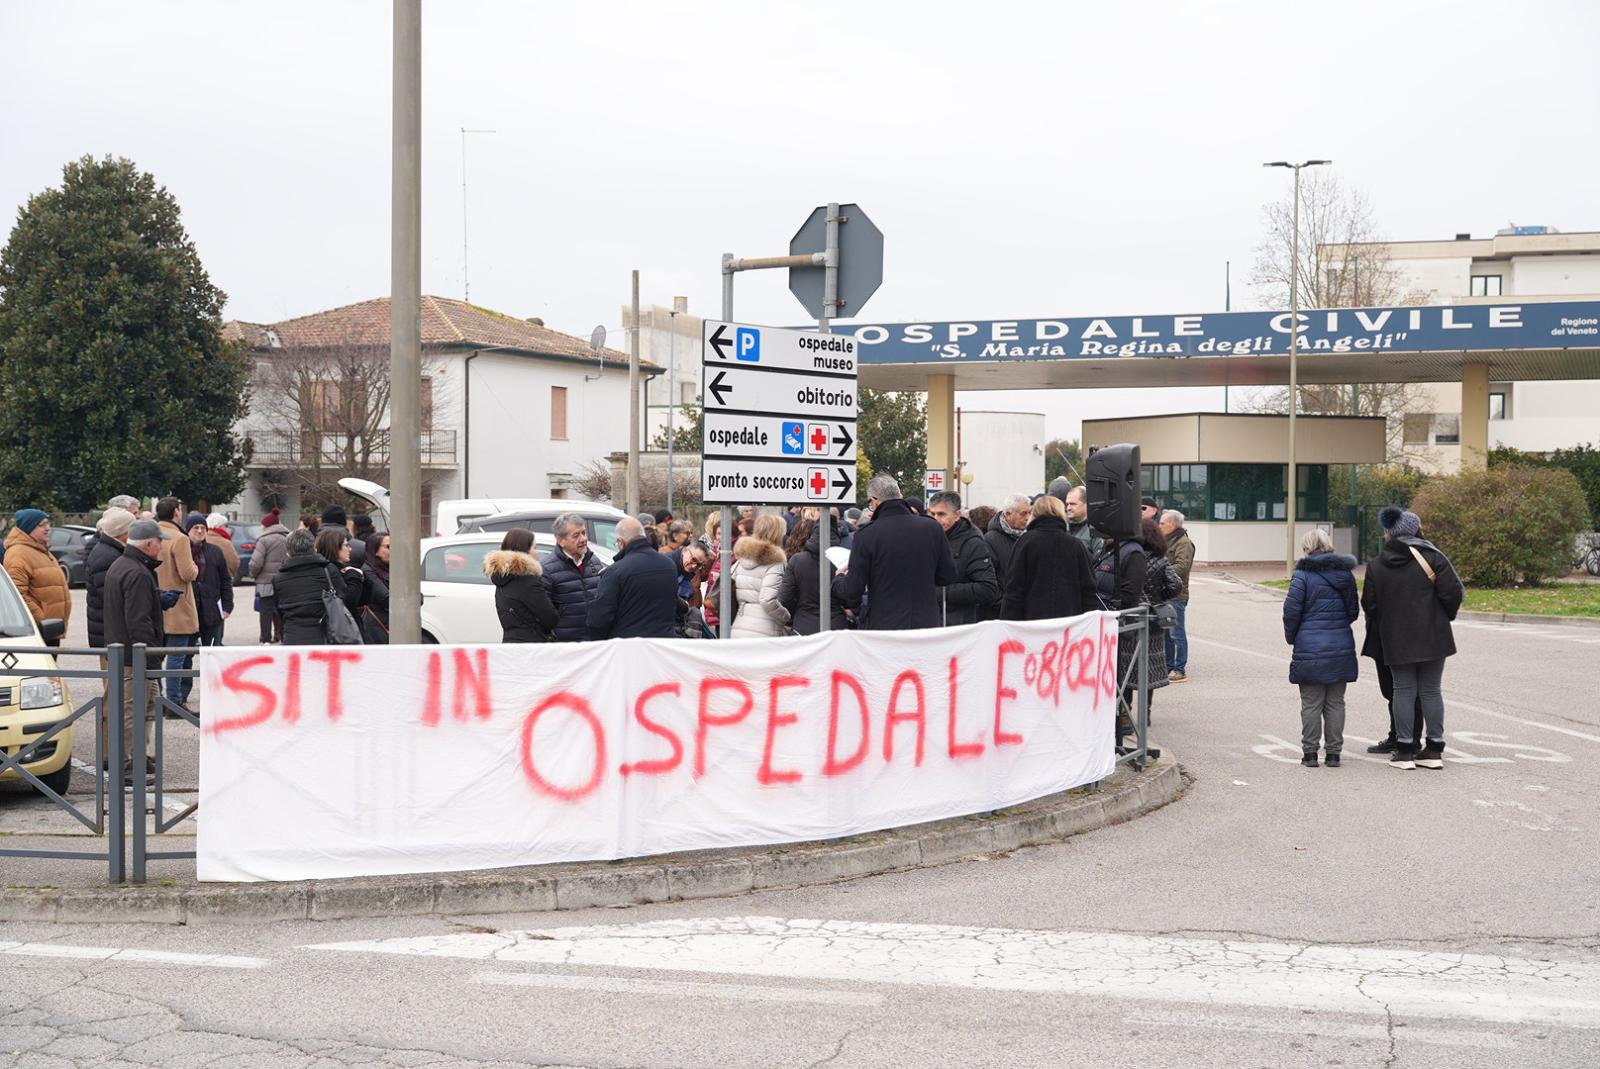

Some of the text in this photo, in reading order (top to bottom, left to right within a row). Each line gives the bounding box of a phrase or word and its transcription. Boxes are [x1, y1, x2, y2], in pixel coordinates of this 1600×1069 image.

[854, 306, 1523, 345] OSPEDALE CIVILE
[1551, 327, 1598, 336] del Veneto
[1560, 317, 1598, 327] Regione
[741, 333, 755, 356] P
[798, 337, 853, 353] ospedale
[980, 342, 1066, 357] Maria
[1080, 341, 1183, 357] Regina
[1198, 337, 1273, 354] degli
[813, 356, 853, 370] museo
[797, 387, 853, 407] obitorio
[709, 426, 768, 447] ospedale
[708, 472, 804, 491] pronto soccorso
[203, 650, 363, 736] SIT
[421, 648, 493, 727] IN
[521, 638, 1025, 803] OSPEDALE
